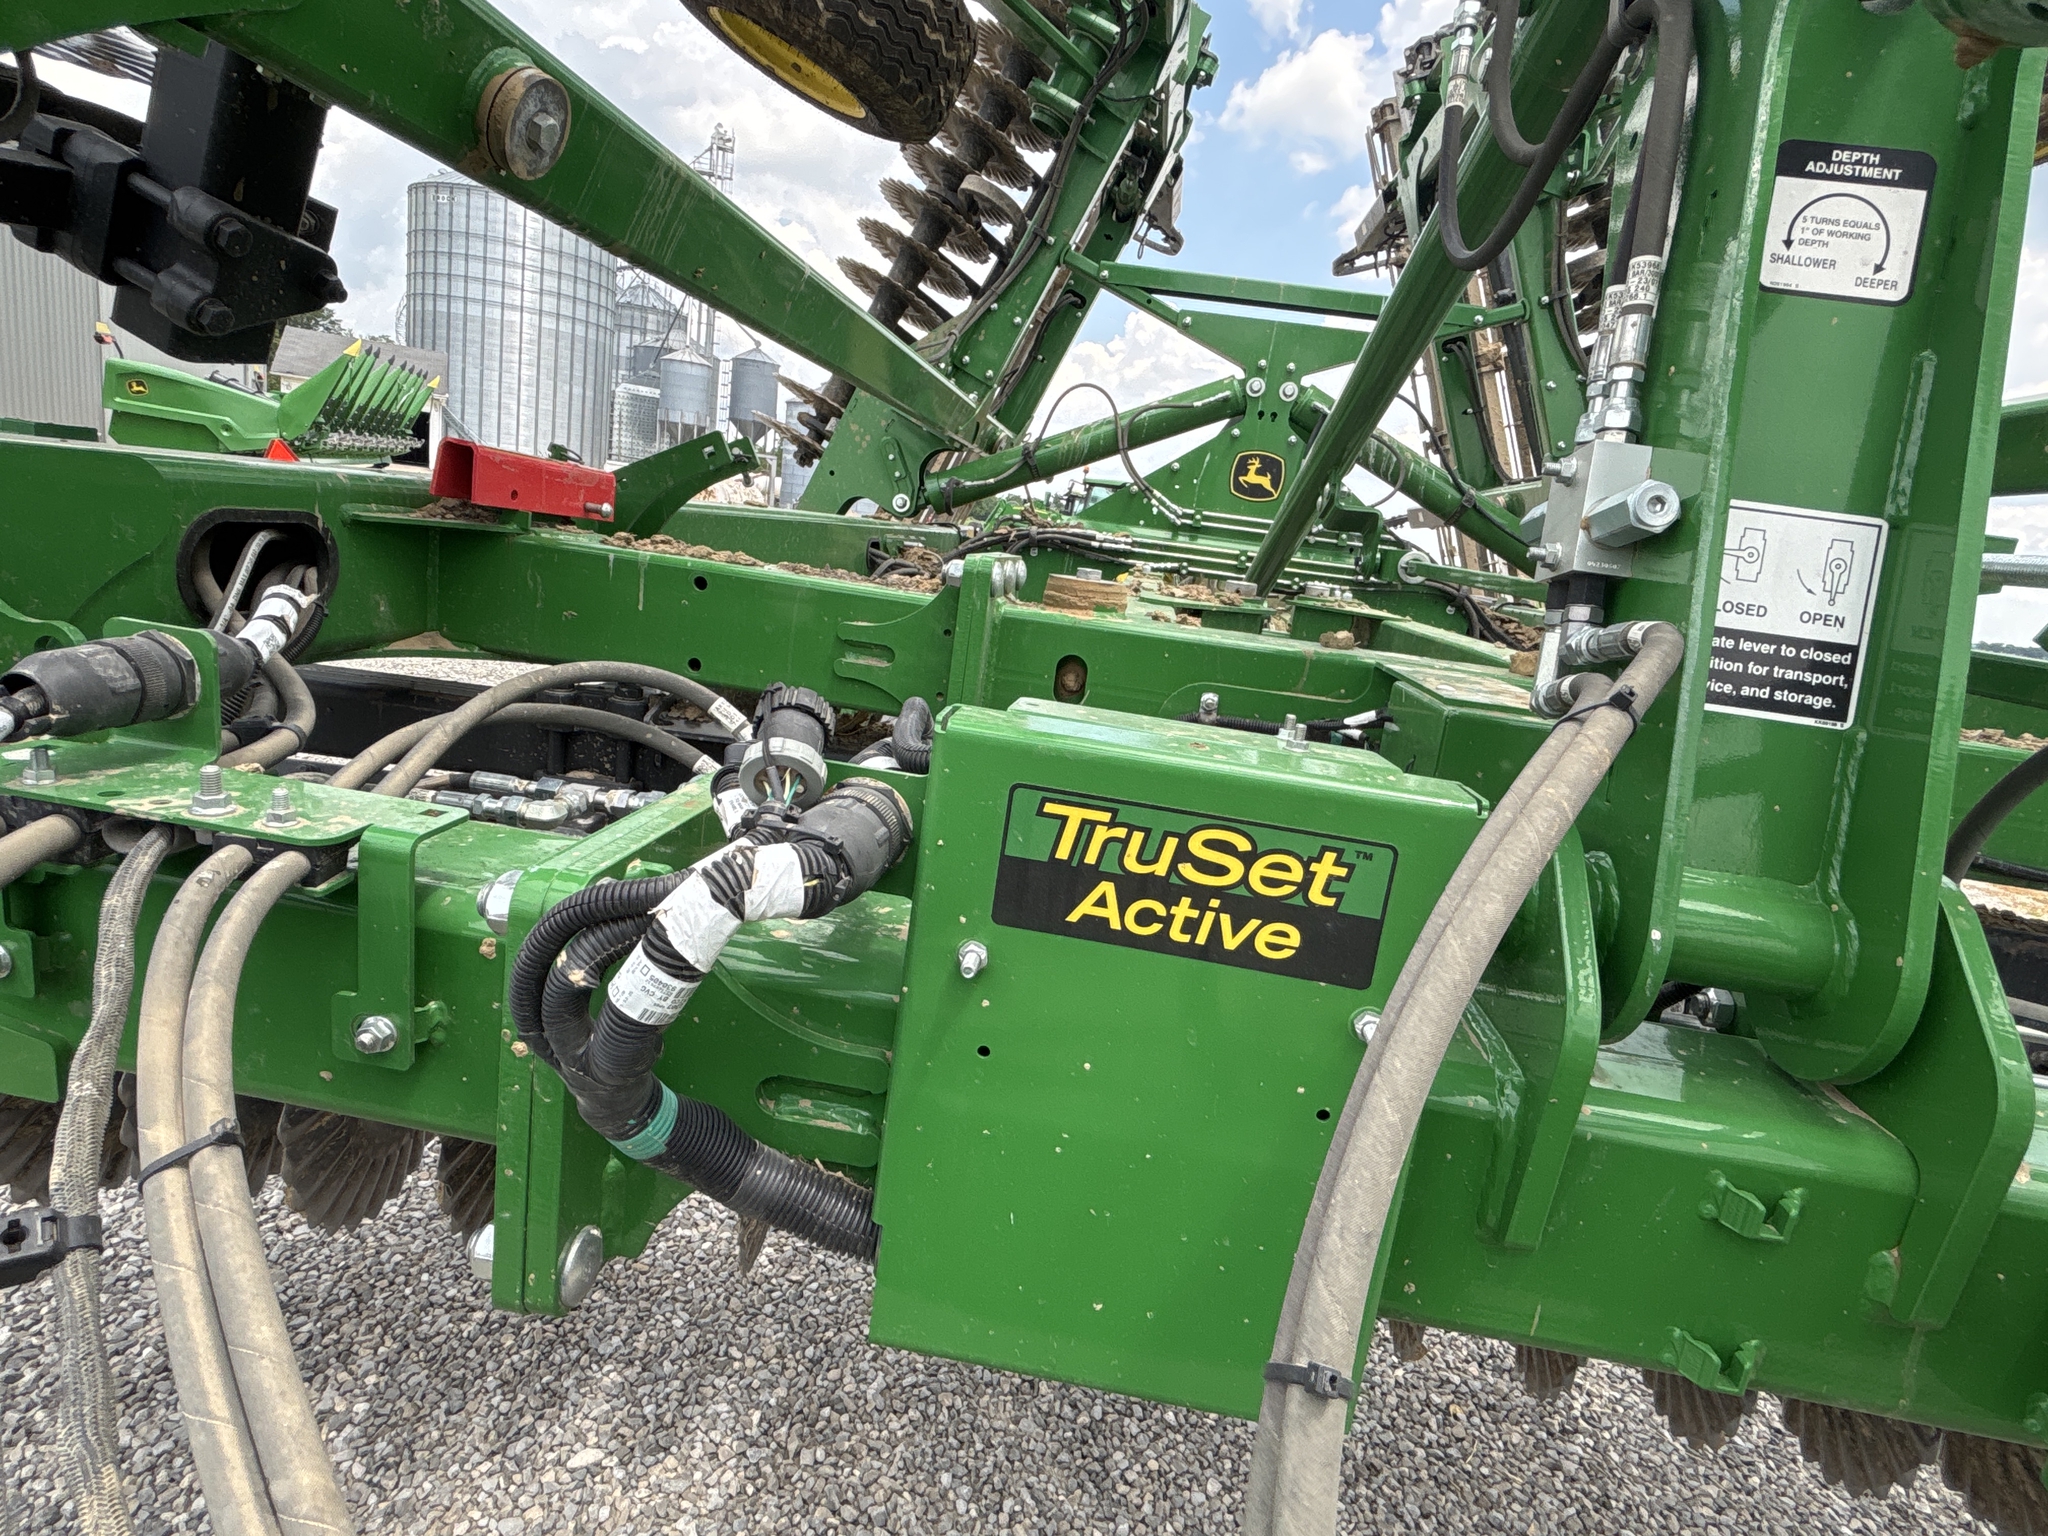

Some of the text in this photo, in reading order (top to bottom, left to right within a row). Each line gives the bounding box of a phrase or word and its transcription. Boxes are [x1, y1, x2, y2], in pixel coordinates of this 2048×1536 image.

[1831, 150, 1881, 165] DEPTH
[1805, 160, 1903, 181] ADJUSTMENT
[1802, 215, 1881, 231] 5 TURNS EQUALS
[1797, 238, 1829, 249] DEPTH
[1811, 228, 1825, 237] OF
[1826, 229, 1872, 242] WORKING
[1769, 252, 1837, 271] SHALLOWER
[1854, 276, 1898, 292] DEEPER
[1715, 600, 1846, 628] OSED OPEN
[1738, 638, 1777, 655] lever
[1780, 644, 1796, 657] to
[1799, 647, 1852, 665] closed
[1747, 662, 1770, 677] for
[1773, 666, 1849, 690] transport,
[1740, 684, 1770, 699] and
[1773, 689, 1837, 709] storage.
[1041, 801, 1349, 907] TruSet
[1066, 880, 1302, 960] Active
